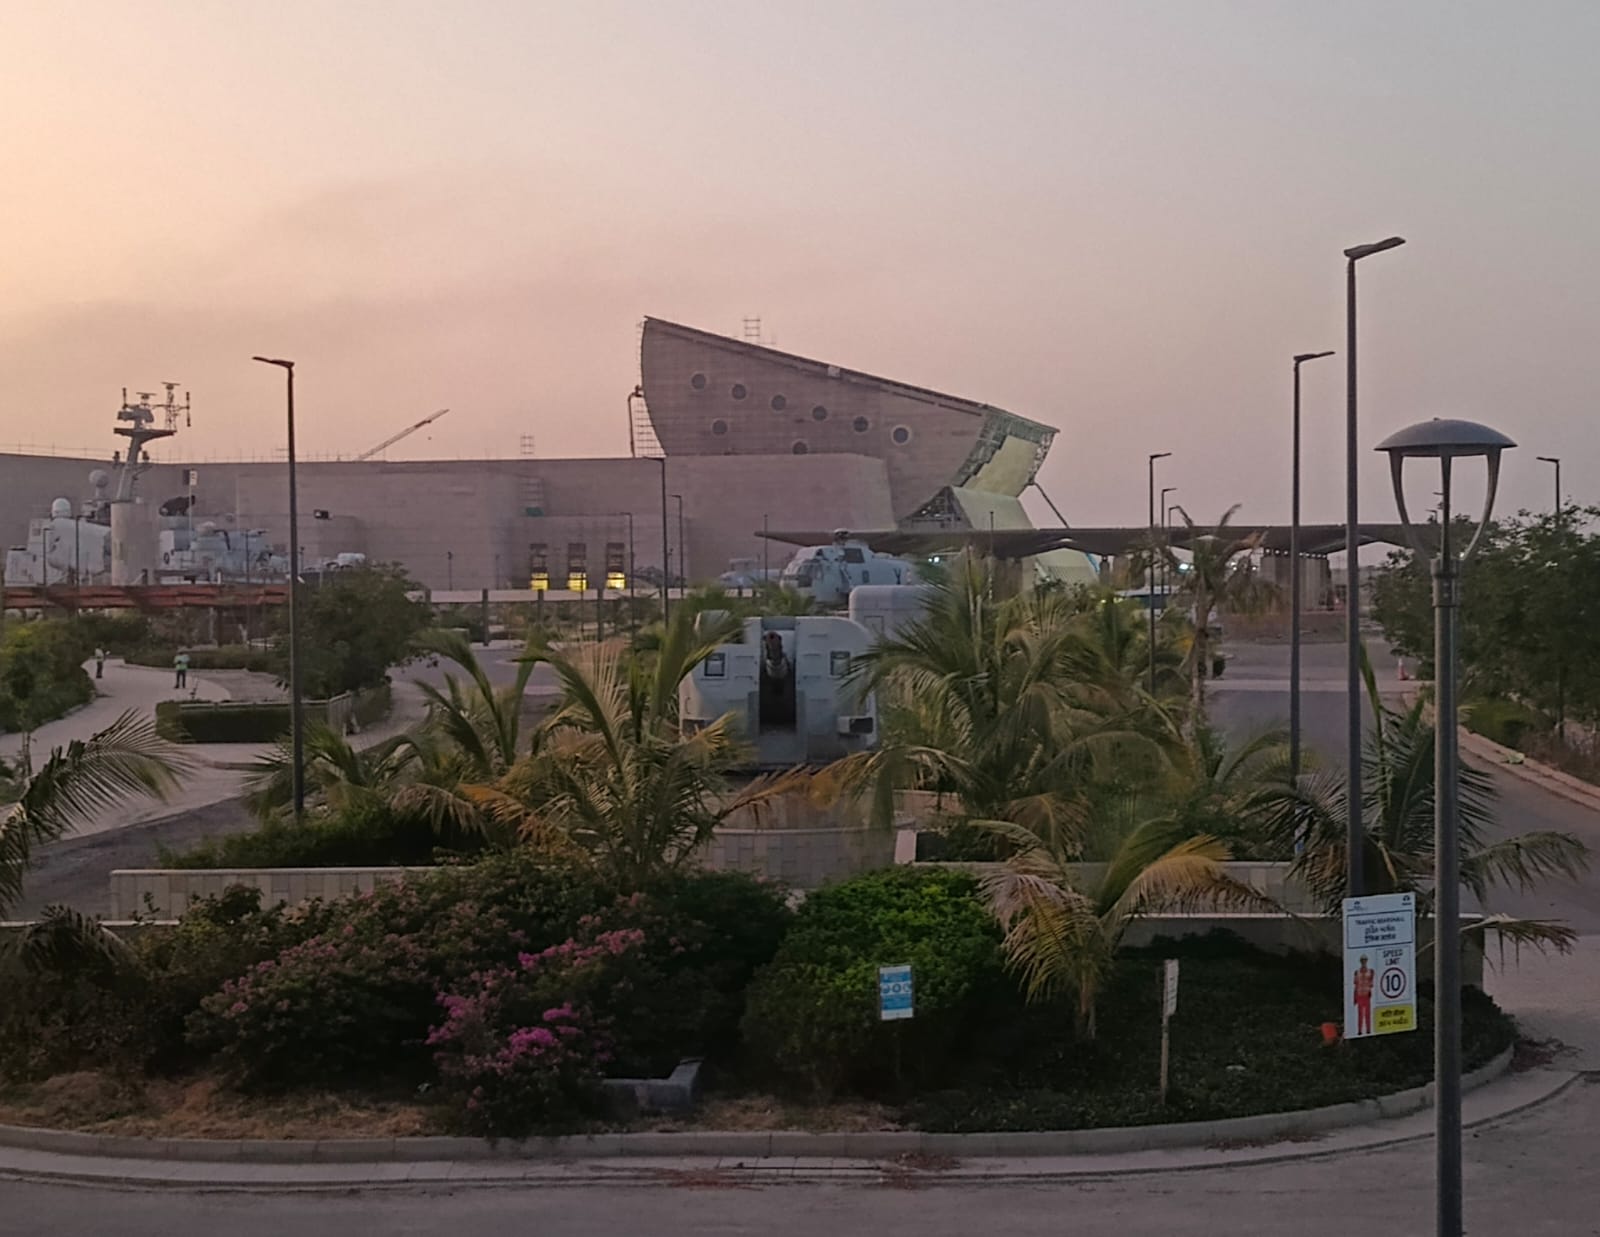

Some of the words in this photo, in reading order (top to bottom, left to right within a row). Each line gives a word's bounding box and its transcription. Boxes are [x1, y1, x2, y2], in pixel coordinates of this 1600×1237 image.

[1383, 949, 1403, 958] SPEED
[1385, 957, 1400, 966] LIMIT
[1385, 974, 1401, 992] 10
